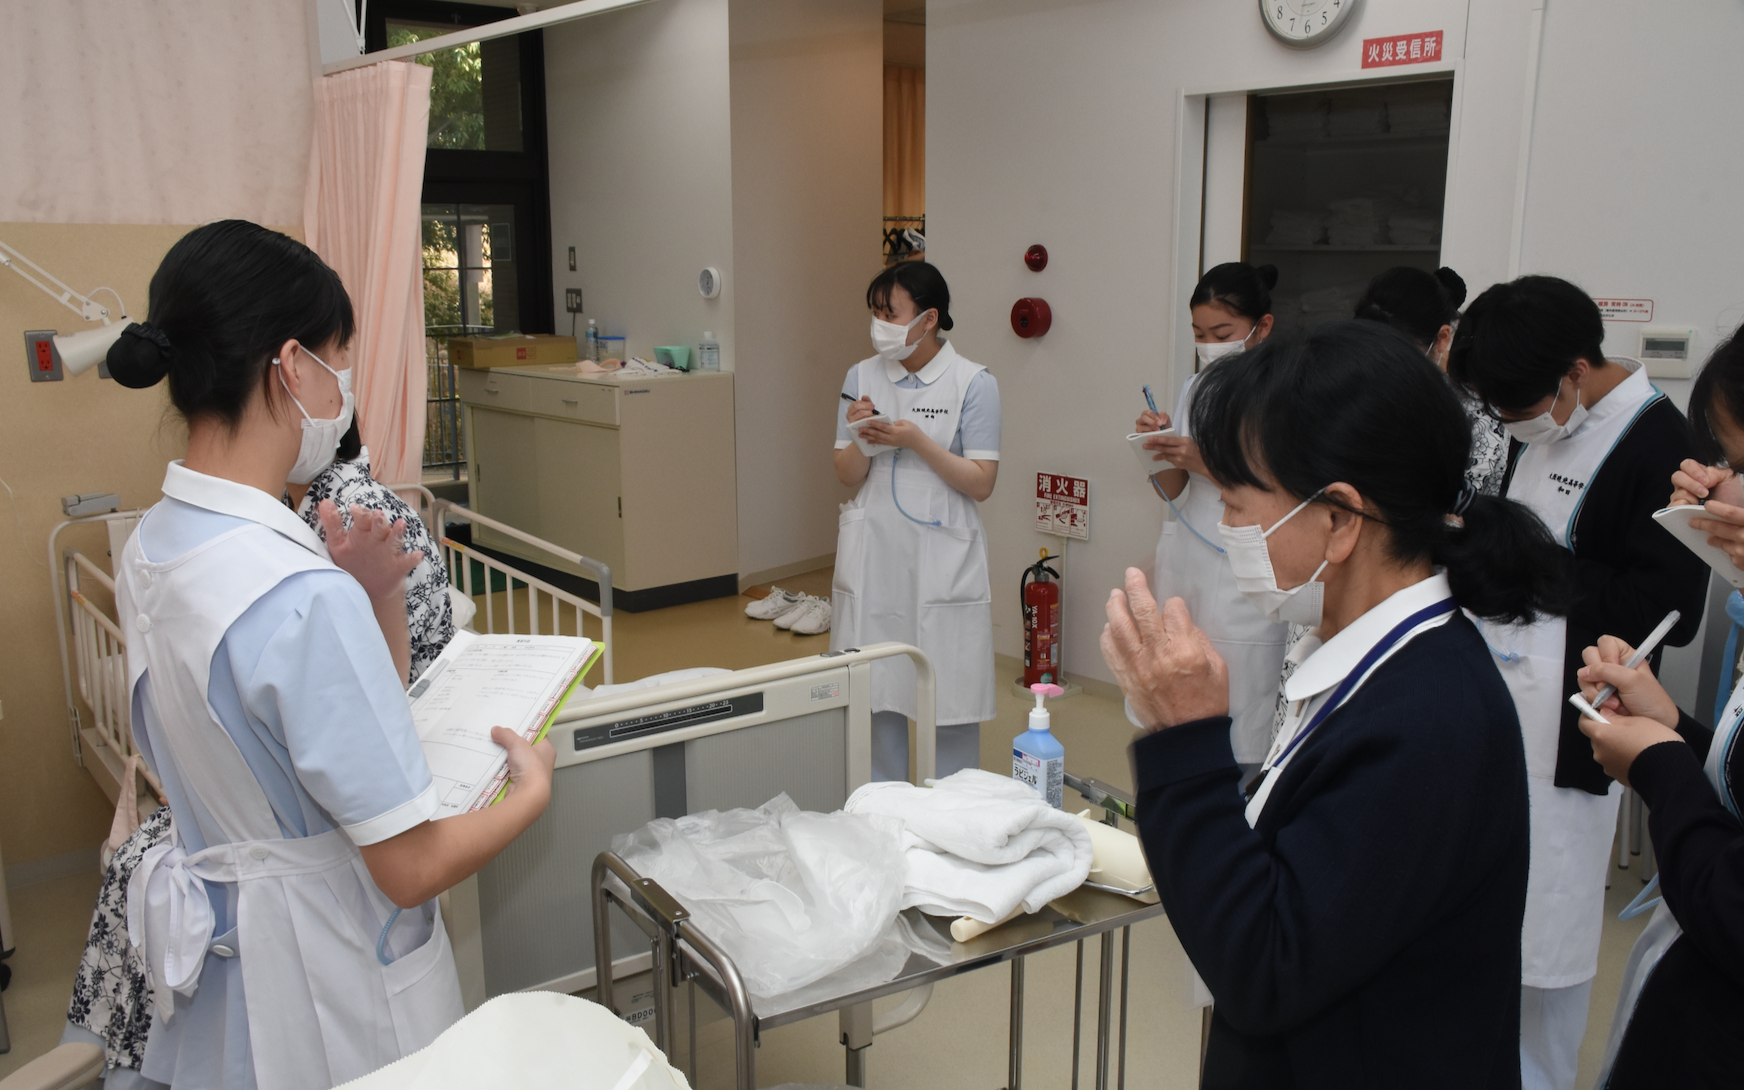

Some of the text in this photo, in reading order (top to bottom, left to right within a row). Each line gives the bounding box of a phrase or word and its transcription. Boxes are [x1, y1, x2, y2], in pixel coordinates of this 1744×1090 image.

[1277, 5, 1283, 20] 8
[1321, 11, 1328, 26] 5
[1289, 17, 1296, 32] 7
[1304, 19, 1311, 34] 6
[1368, 36, 1437, 63] 火災受信所
[1038, 474, 1086, 498] 消火器
[1014, 765, 1037, 786] ラビジェル
